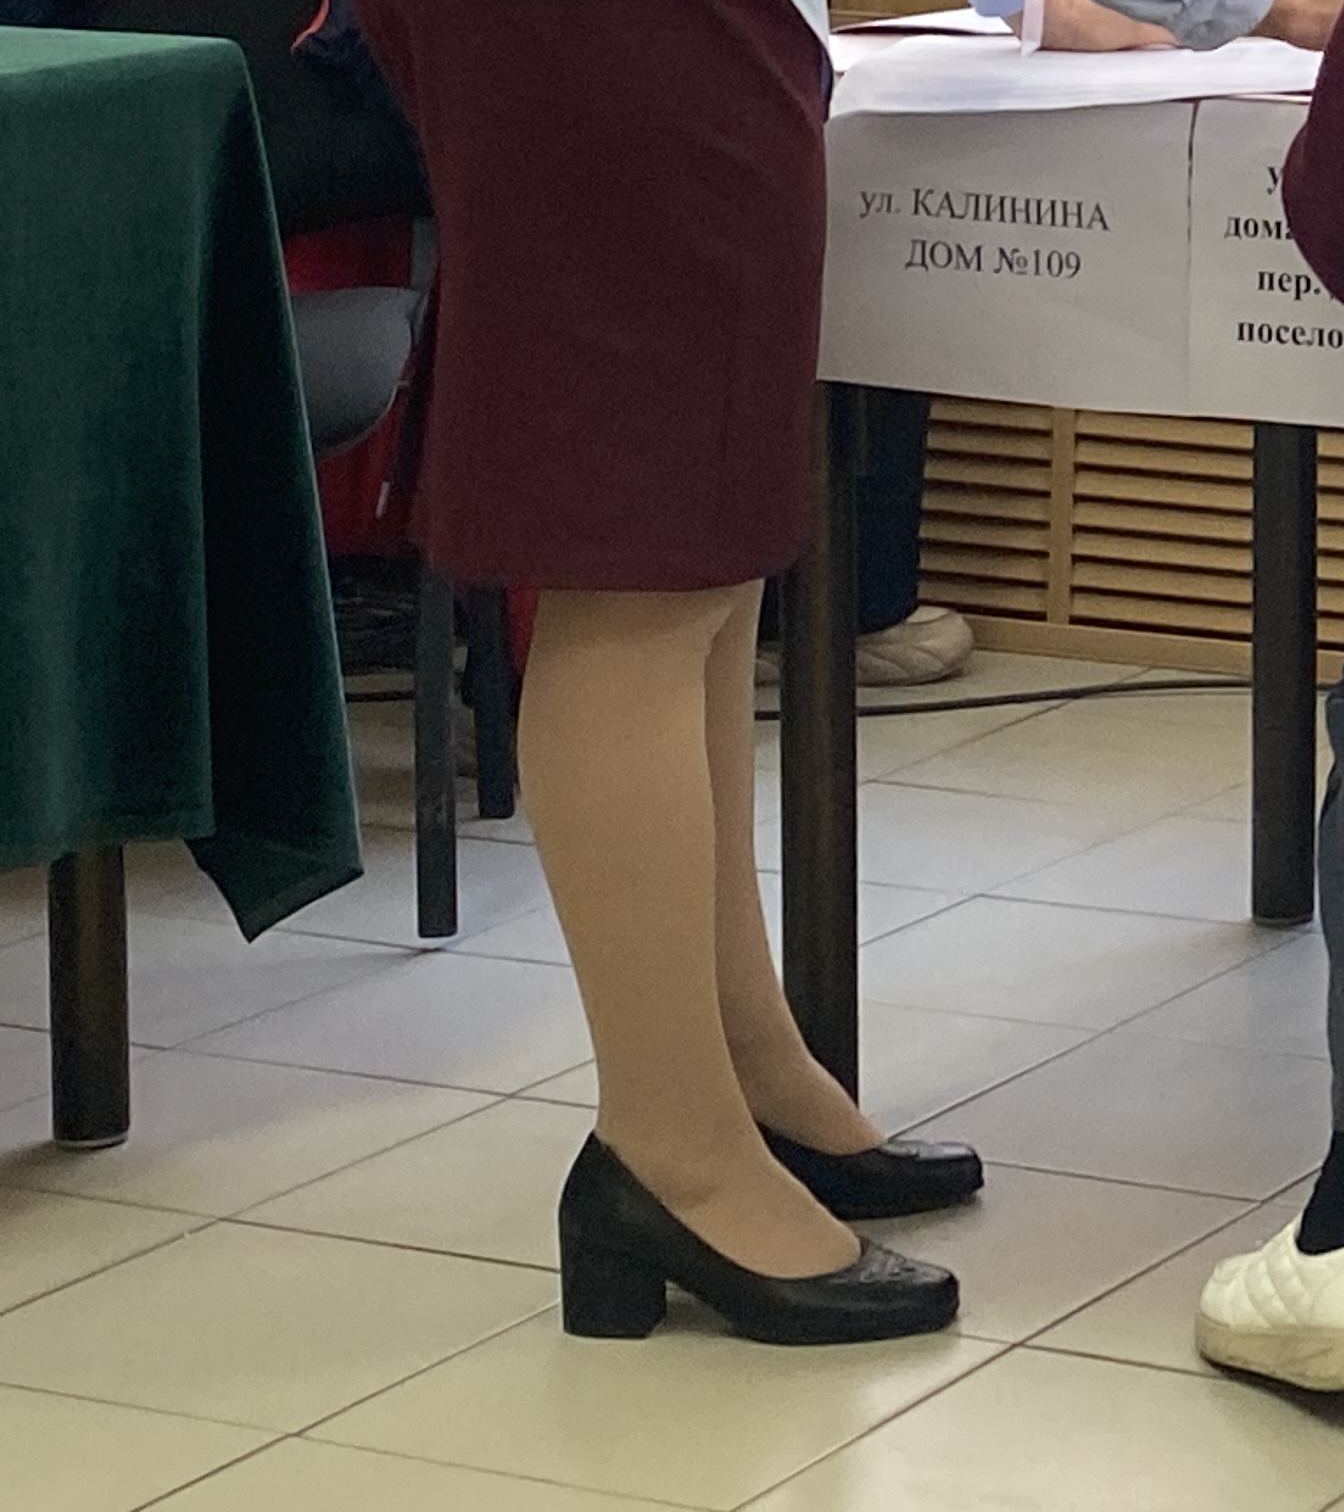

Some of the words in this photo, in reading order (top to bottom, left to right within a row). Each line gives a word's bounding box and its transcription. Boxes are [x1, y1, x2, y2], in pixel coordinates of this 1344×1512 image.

[859, 190, 902, 218] ул.
[911, 187, 1110, 231] КАЛИНИНА
[904, 239, 983, 273] ДОМ
[992, 246, 1082, 279] №109
[1257, 270, 1322, 301] пер.
